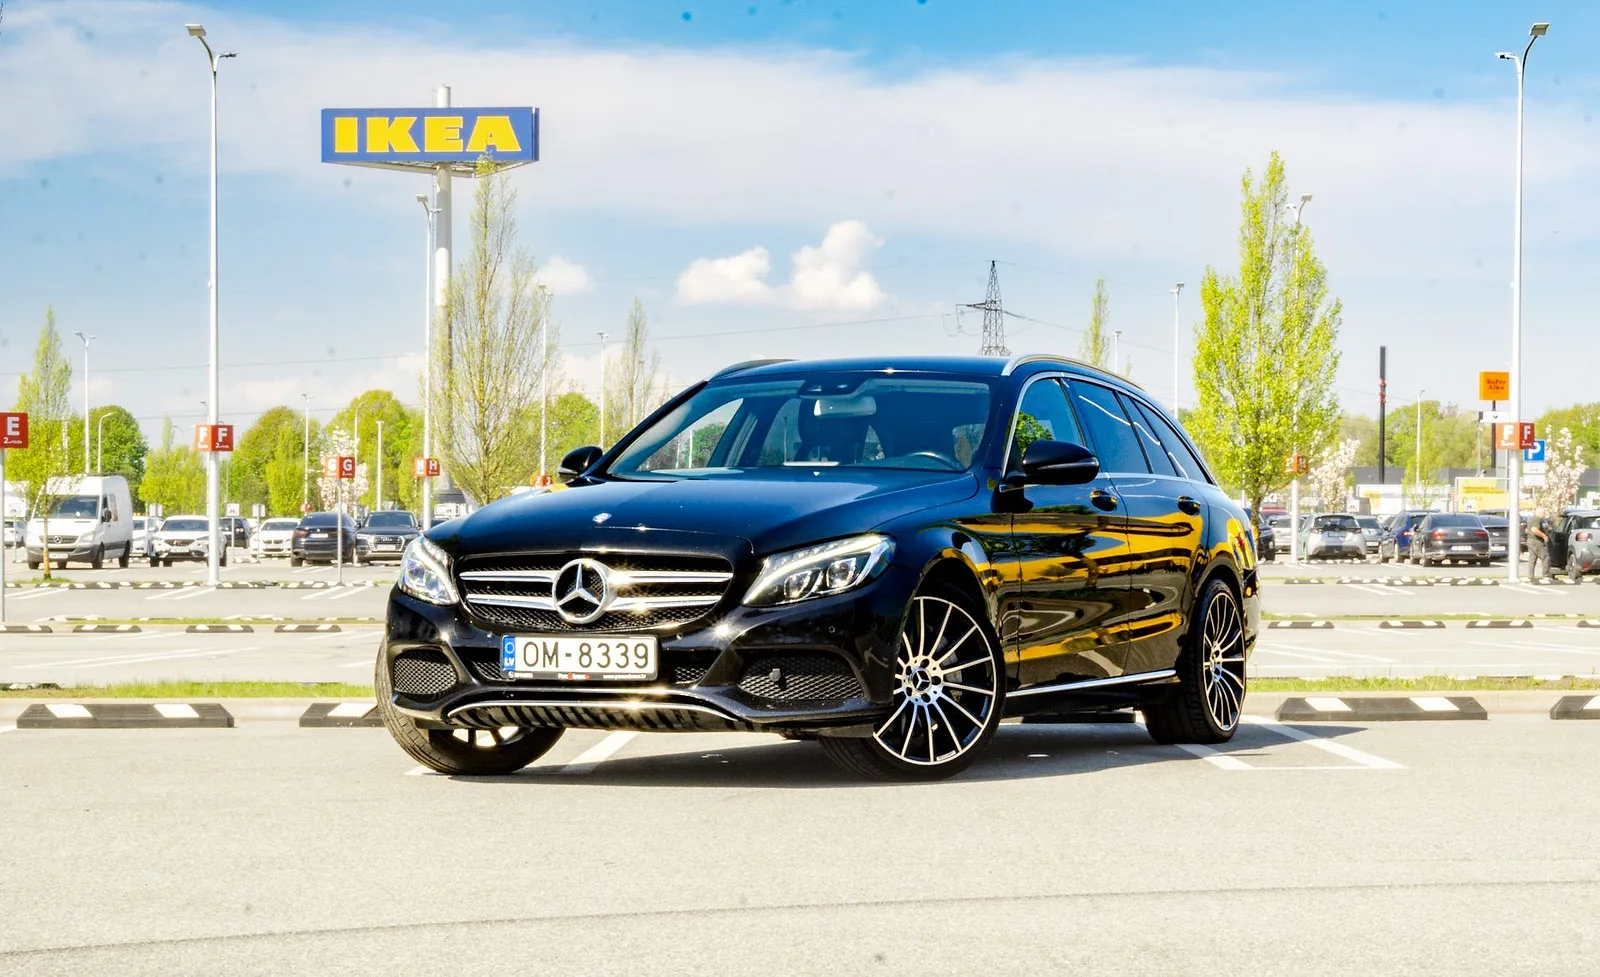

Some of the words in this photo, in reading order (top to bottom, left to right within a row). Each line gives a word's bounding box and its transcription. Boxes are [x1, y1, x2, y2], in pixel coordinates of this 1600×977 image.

[334, 116, 522, 153] IKEA
[7, 416, 20, 436] E
[1503, 424, 1514, 441] F
[1524, 425, 1531, 440] F
[218, 427, 228, 442] F
[1528, 441, 1541, 460] P
[343, 459, 353, 471] G
[429, 460, 438, 470] H
[504, 657, 514, 666] LV
[523, 641, 649, 669] OM-8339
